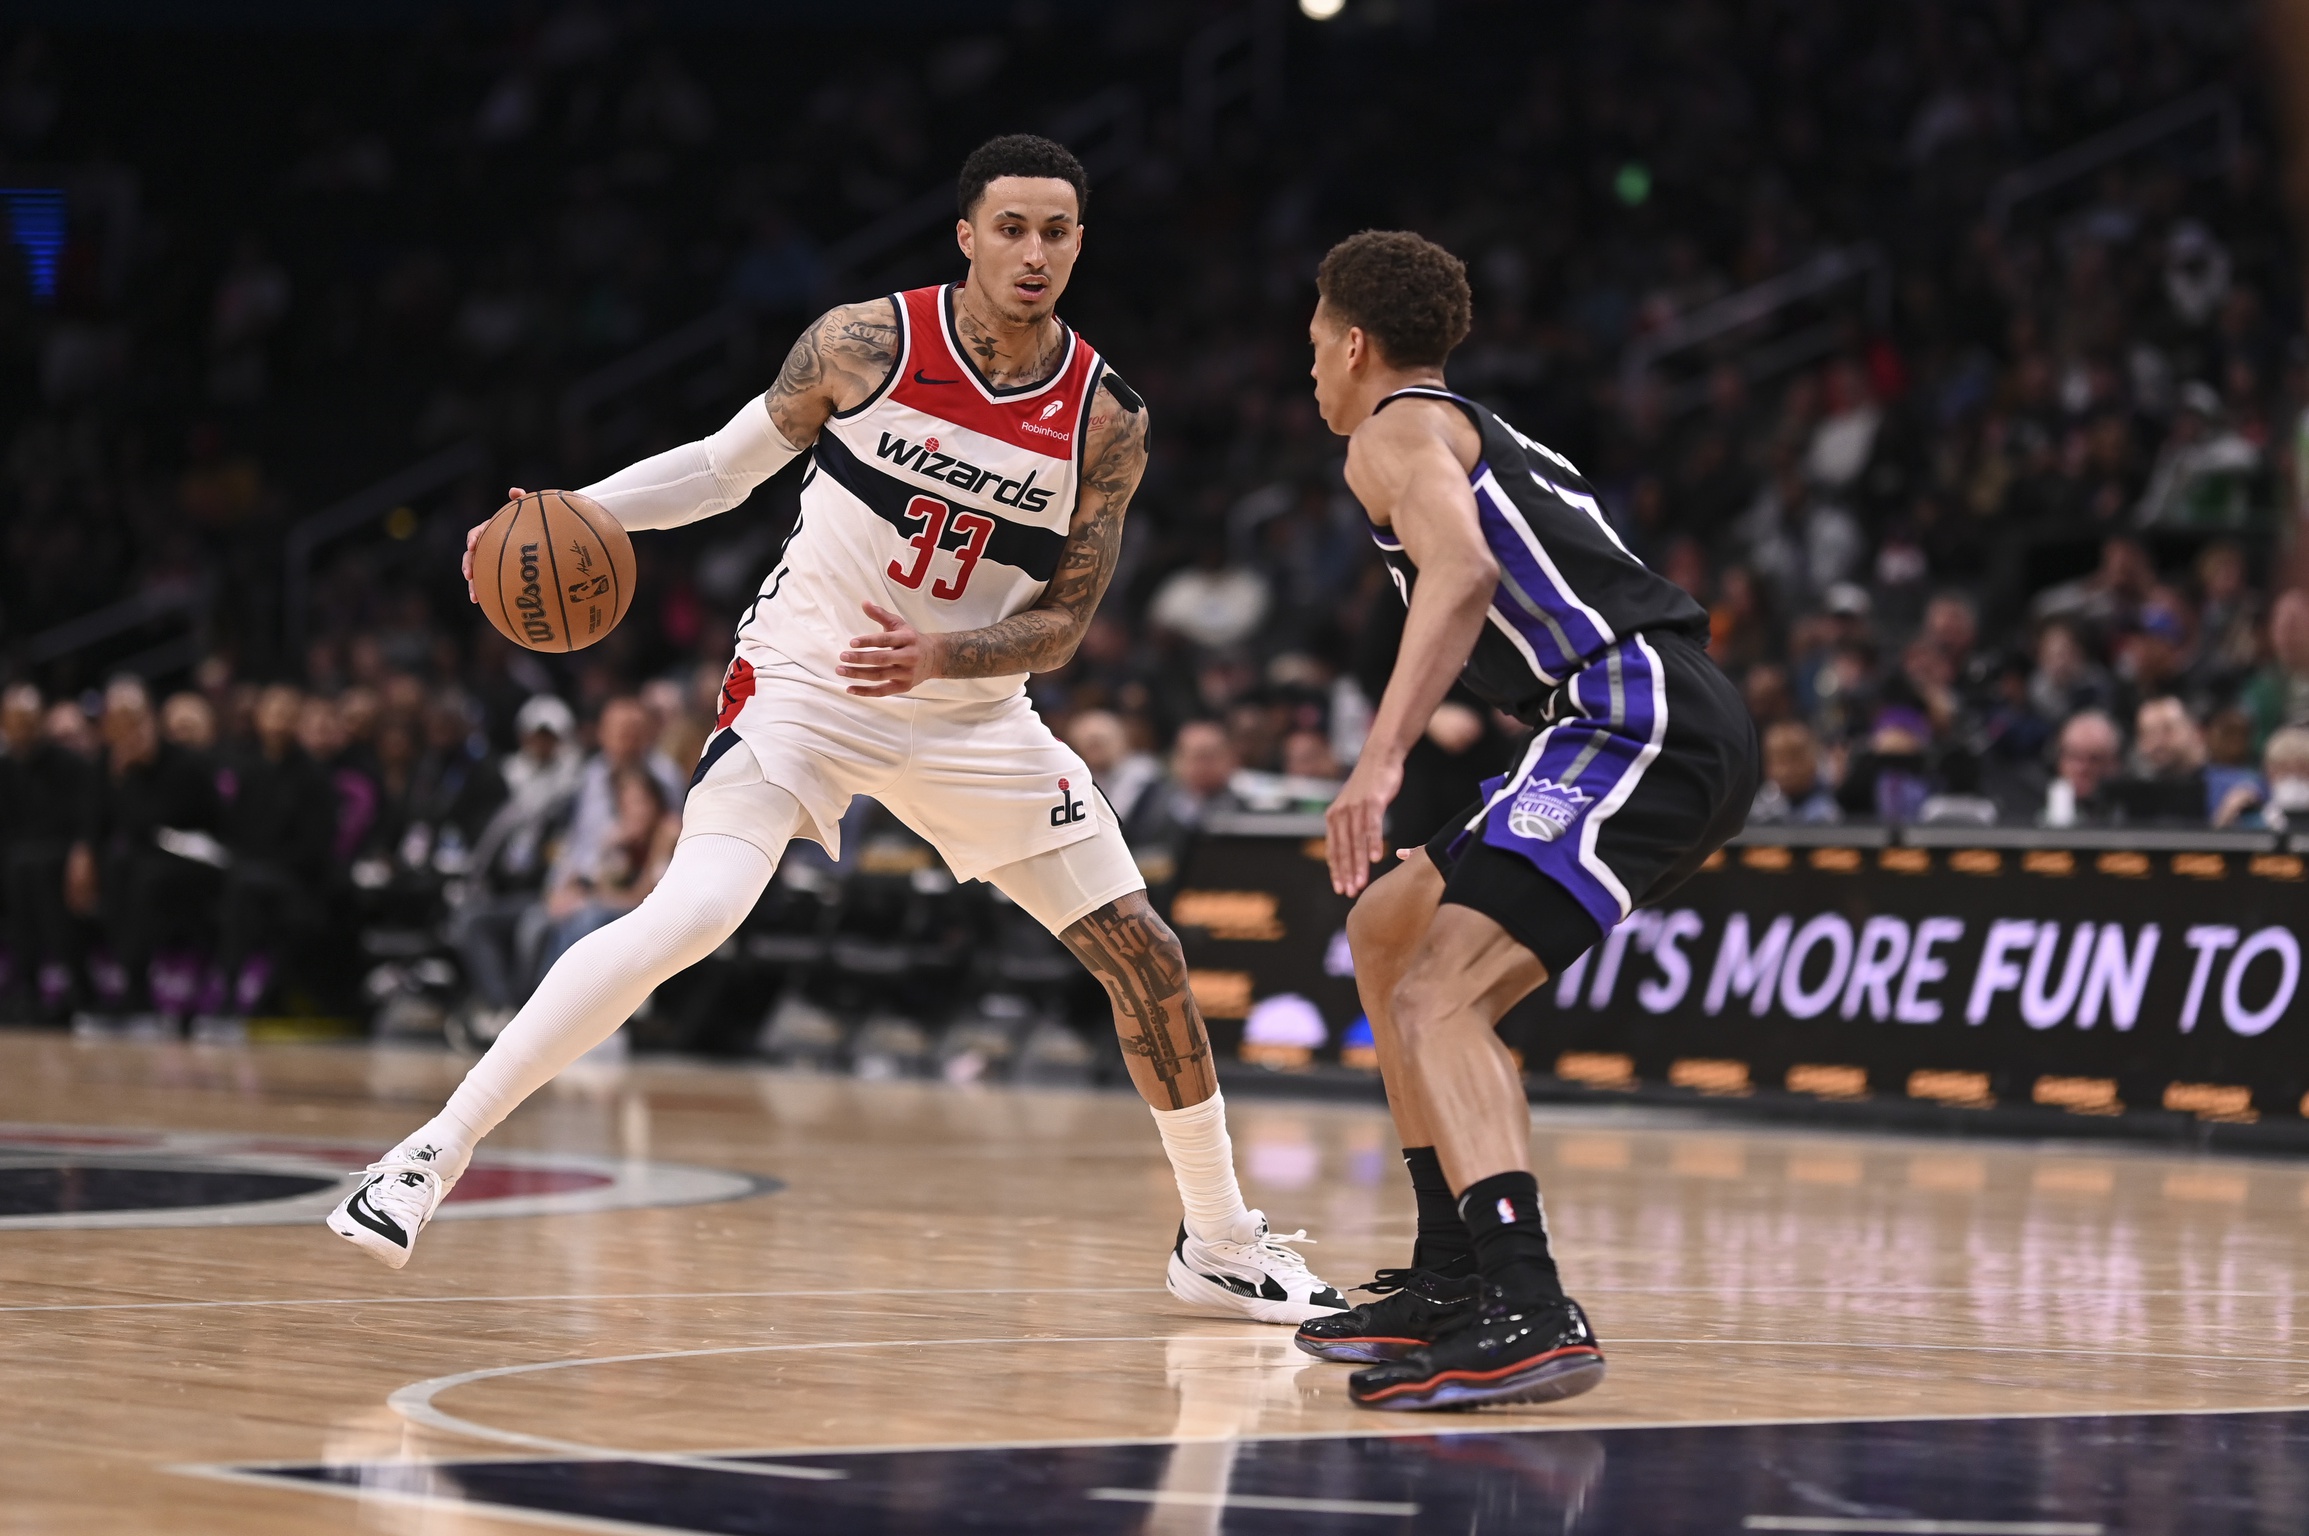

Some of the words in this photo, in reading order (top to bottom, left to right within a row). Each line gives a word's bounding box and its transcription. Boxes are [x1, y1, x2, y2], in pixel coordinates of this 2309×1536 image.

[876, 431, 1056, 513] wizards
[1021, 421, 1070, 441] Robinhood
[515, 541, 555, 644] Wilson
[887, 497, 995, 601] 33
[1515, 800, 1574, 828] KINGS
[1704, 912, 1965, 1023] MORE
[1966, 918, 2159, 1031] FUN
[2180, 925, 2301, 1037] TO
